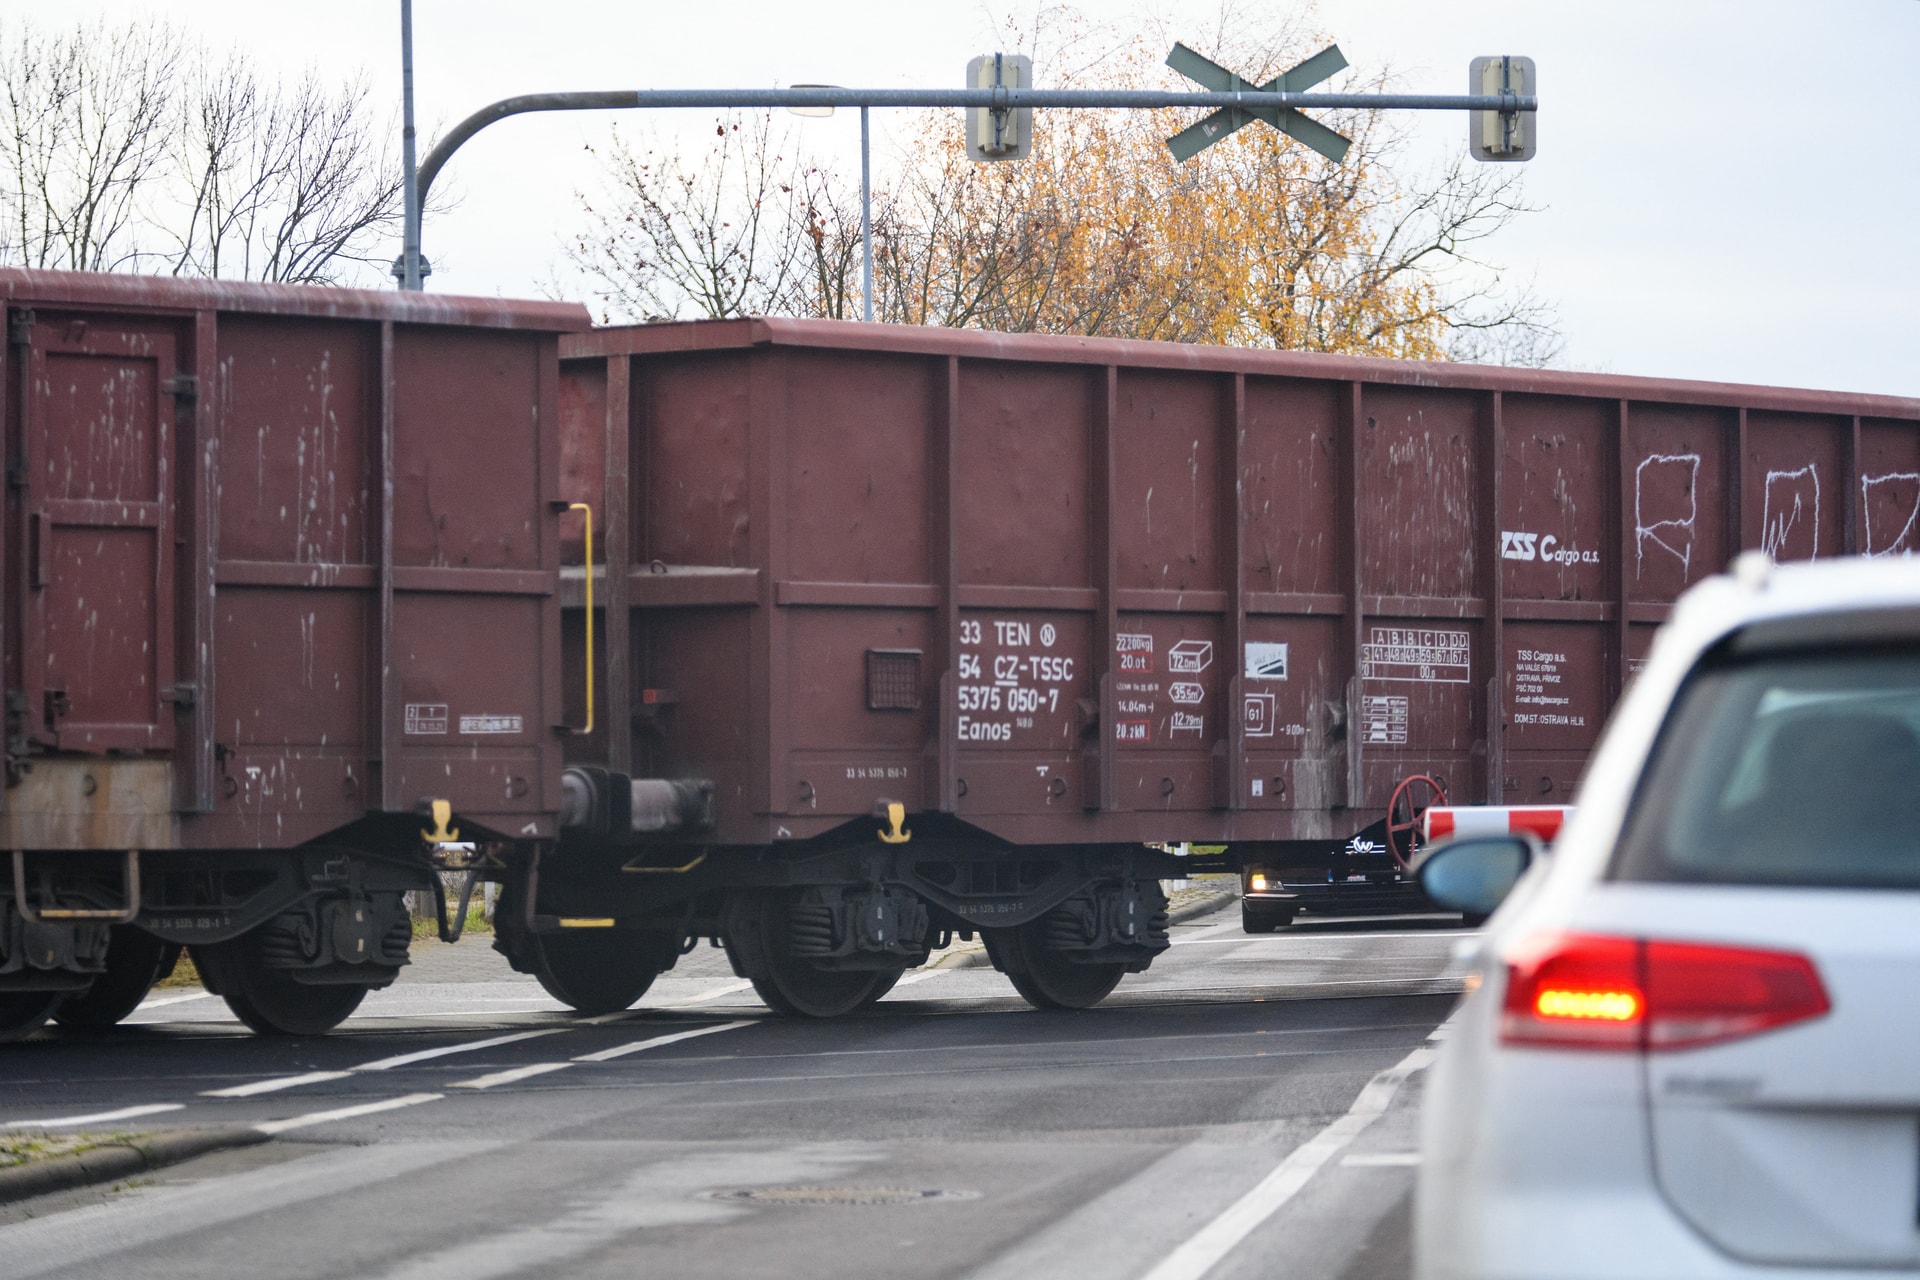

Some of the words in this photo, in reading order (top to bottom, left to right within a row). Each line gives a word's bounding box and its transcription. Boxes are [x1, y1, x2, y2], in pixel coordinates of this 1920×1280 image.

[1540, 534, 1579, 566] Cargo
[1582, 550, 1600, 563] a.s.
[960, 620, 981, 644] 33
[993, 621, 1030, 646] TEN
[1377, 631, 1385, 644] A
[959, 654, 981, 679] 54
[994, 655, 1073, 681] CZ-TSSC
[1517, 650, 1532, 661] TSS
[1533, 650, 1553, 664] Cargo
[958, 686, 1001, 711] 5375
[1008, 688, 1059, 713] 050-7
[1248, 708, 1259, 720] G1
[958, 716, 1011, 740] Eanos
